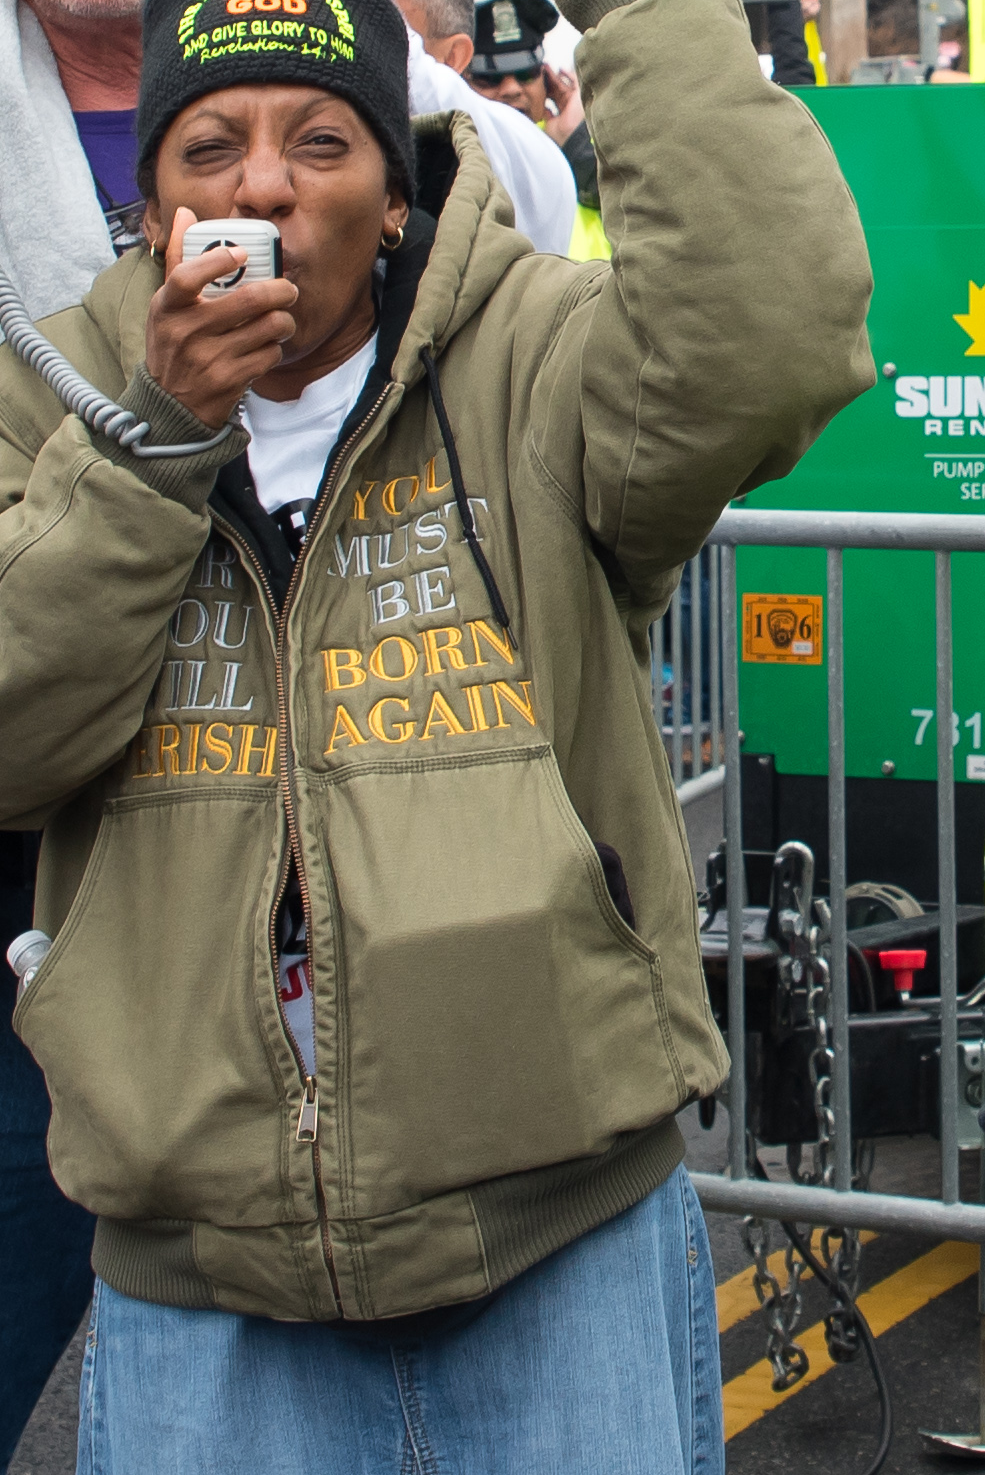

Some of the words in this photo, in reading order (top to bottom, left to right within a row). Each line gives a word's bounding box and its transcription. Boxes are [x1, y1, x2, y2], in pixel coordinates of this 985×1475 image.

[182, 32, 210, 61] AND
[210, 21, 248, 43] GIVE
[250, 19, 305, 38] GLORY
[308, 26, 328, 46] TO
[200, 37, 296, 66] Revelation
[960, 482, 985, 501] SE
[327, 497, 490, 580] MUST
[367, 565, 457, 628] BE
[168, 598, 256, 651] OU
[321, 619, 517, 694] BORN
[165, 659, 255, 712] ILL
[324, 680, 538, 756] AGAIN
[132, 722, 278, 780] ERISH
